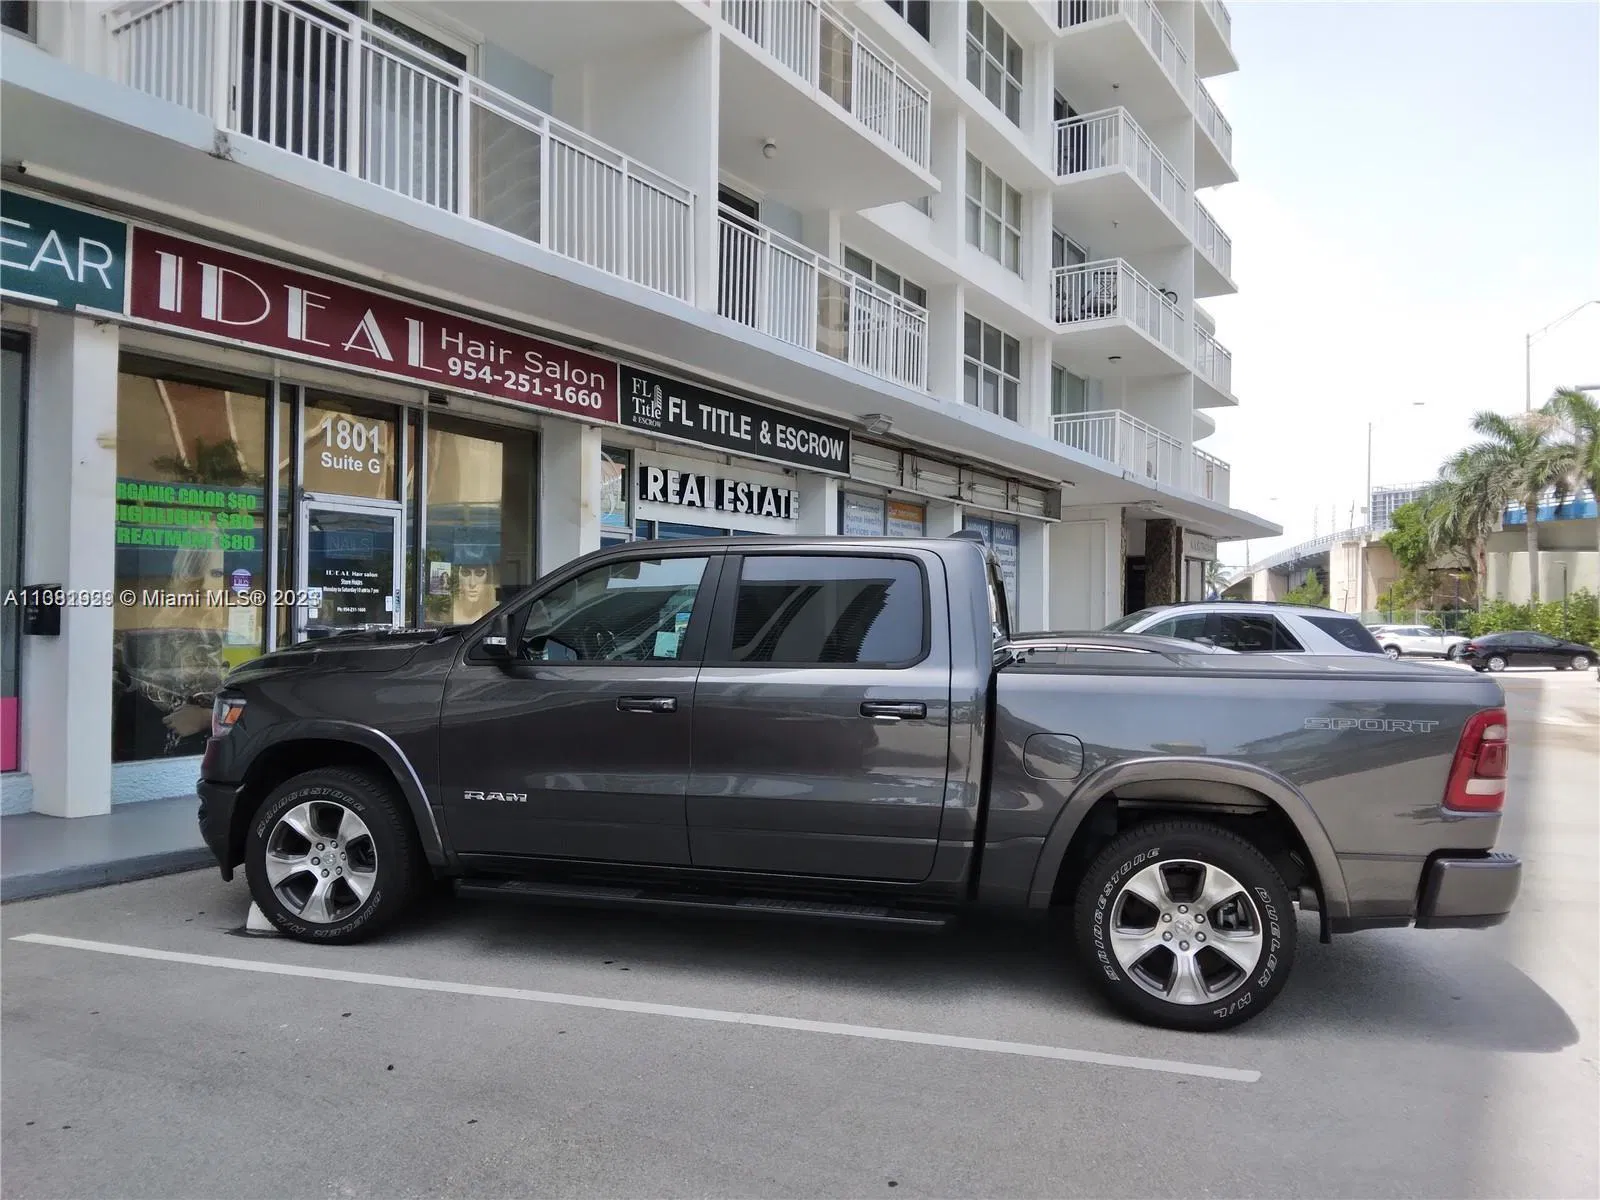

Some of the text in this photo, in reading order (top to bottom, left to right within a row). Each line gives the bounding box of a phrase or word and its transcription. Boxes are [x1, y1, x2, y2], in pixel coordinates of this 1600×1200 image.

[0, 217, 113, 289] EAR
[155, 250, 605, 390] IDEAL Hair Salon
[447, 356, 602, 409] 954-251-1660
[632, 377, 651, 398] FL
[632, 396, 662, 419] Title
[321, 416, 380, 453] 1801
[668, 396, 844, 461] FL TITLE & ESCROW
[321, 452, 381, 474] Suite G
[178, 487, 225, 507] COLOR
[645, 466, 799, 520] REAL ESTATE
[116, 504, 213, 526] IGHLIGHT
[219, 533, 256, 551] $80
[1303, 717, 1440, 733] SPORT
[463, 790, 528, 803] RAM
[1092, 847, 1161, 983] BRIDGESTONE
[1254, 886, 1282, 989] DUELER
